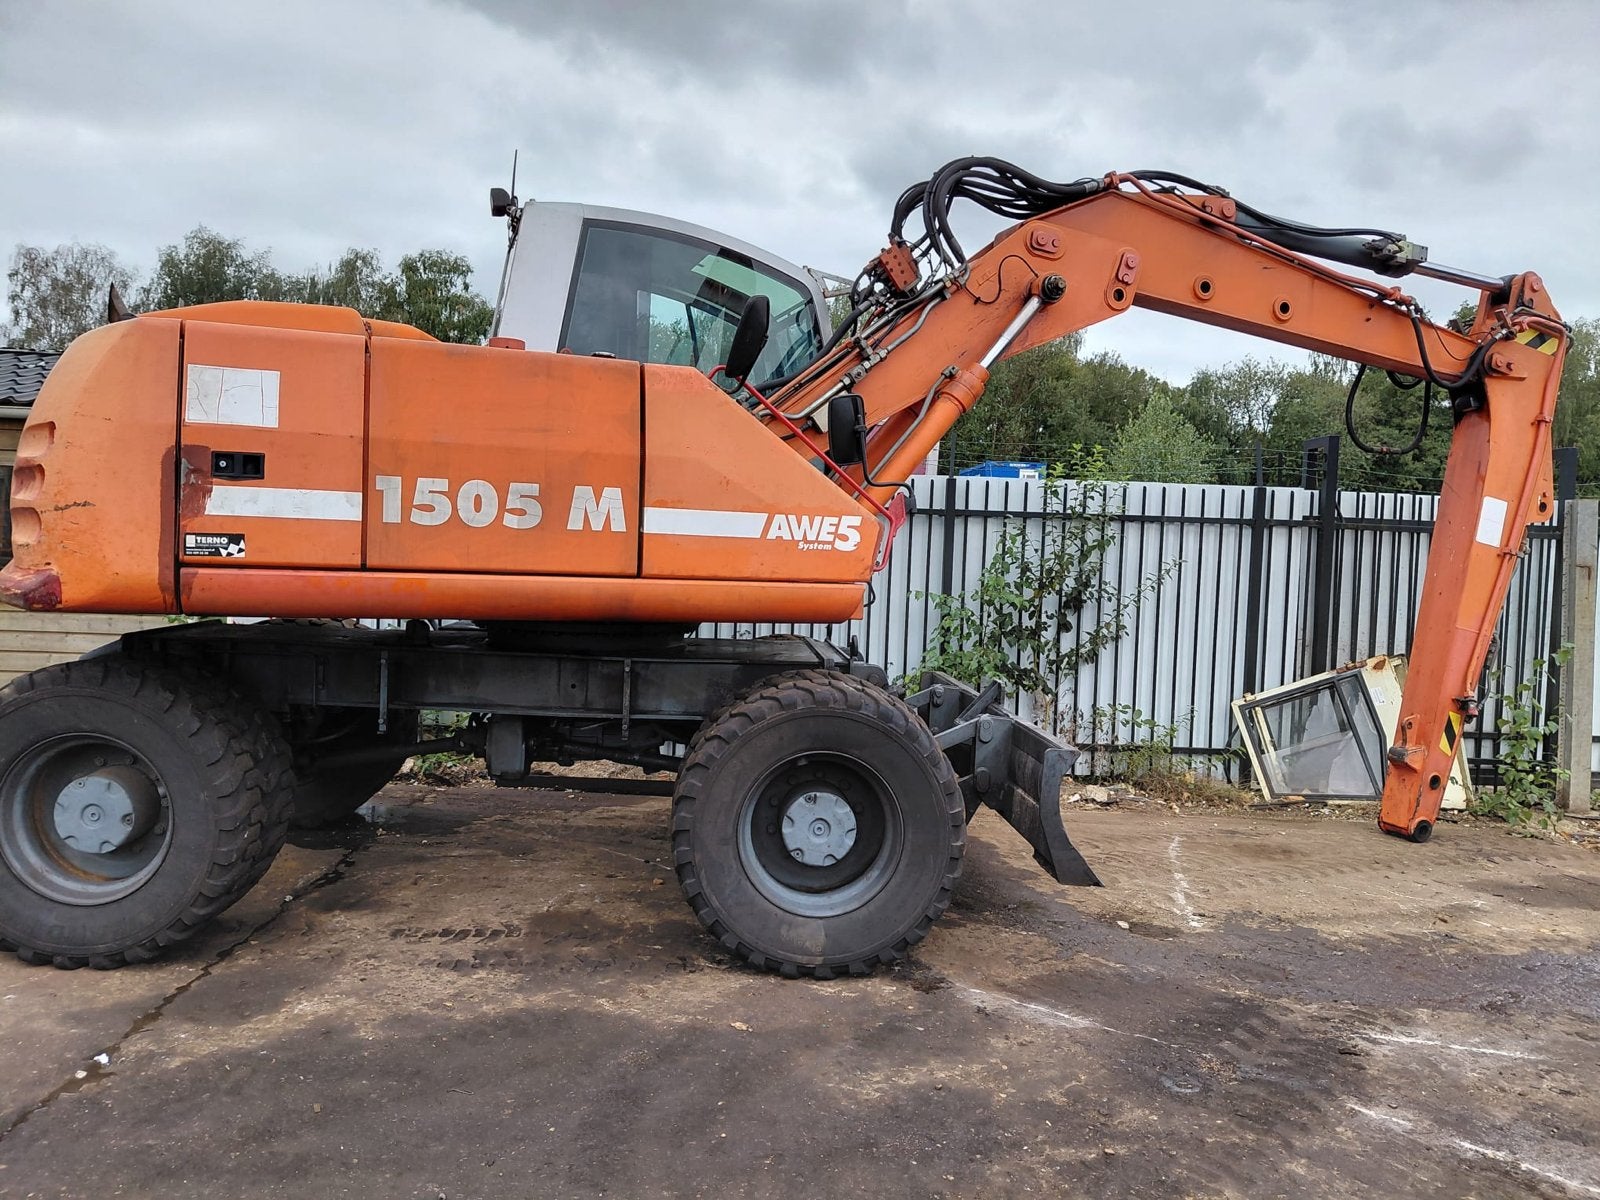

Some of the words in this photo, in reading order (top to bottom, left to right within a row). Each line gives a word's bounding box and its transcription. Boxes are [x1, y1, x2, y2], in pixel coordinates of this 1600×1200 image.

[375, 475, 543, 529] 1505
[566, 485, 627, 532] M
[196, 536, 228, 544] TERNO
[798, 541, 832, 551] System
